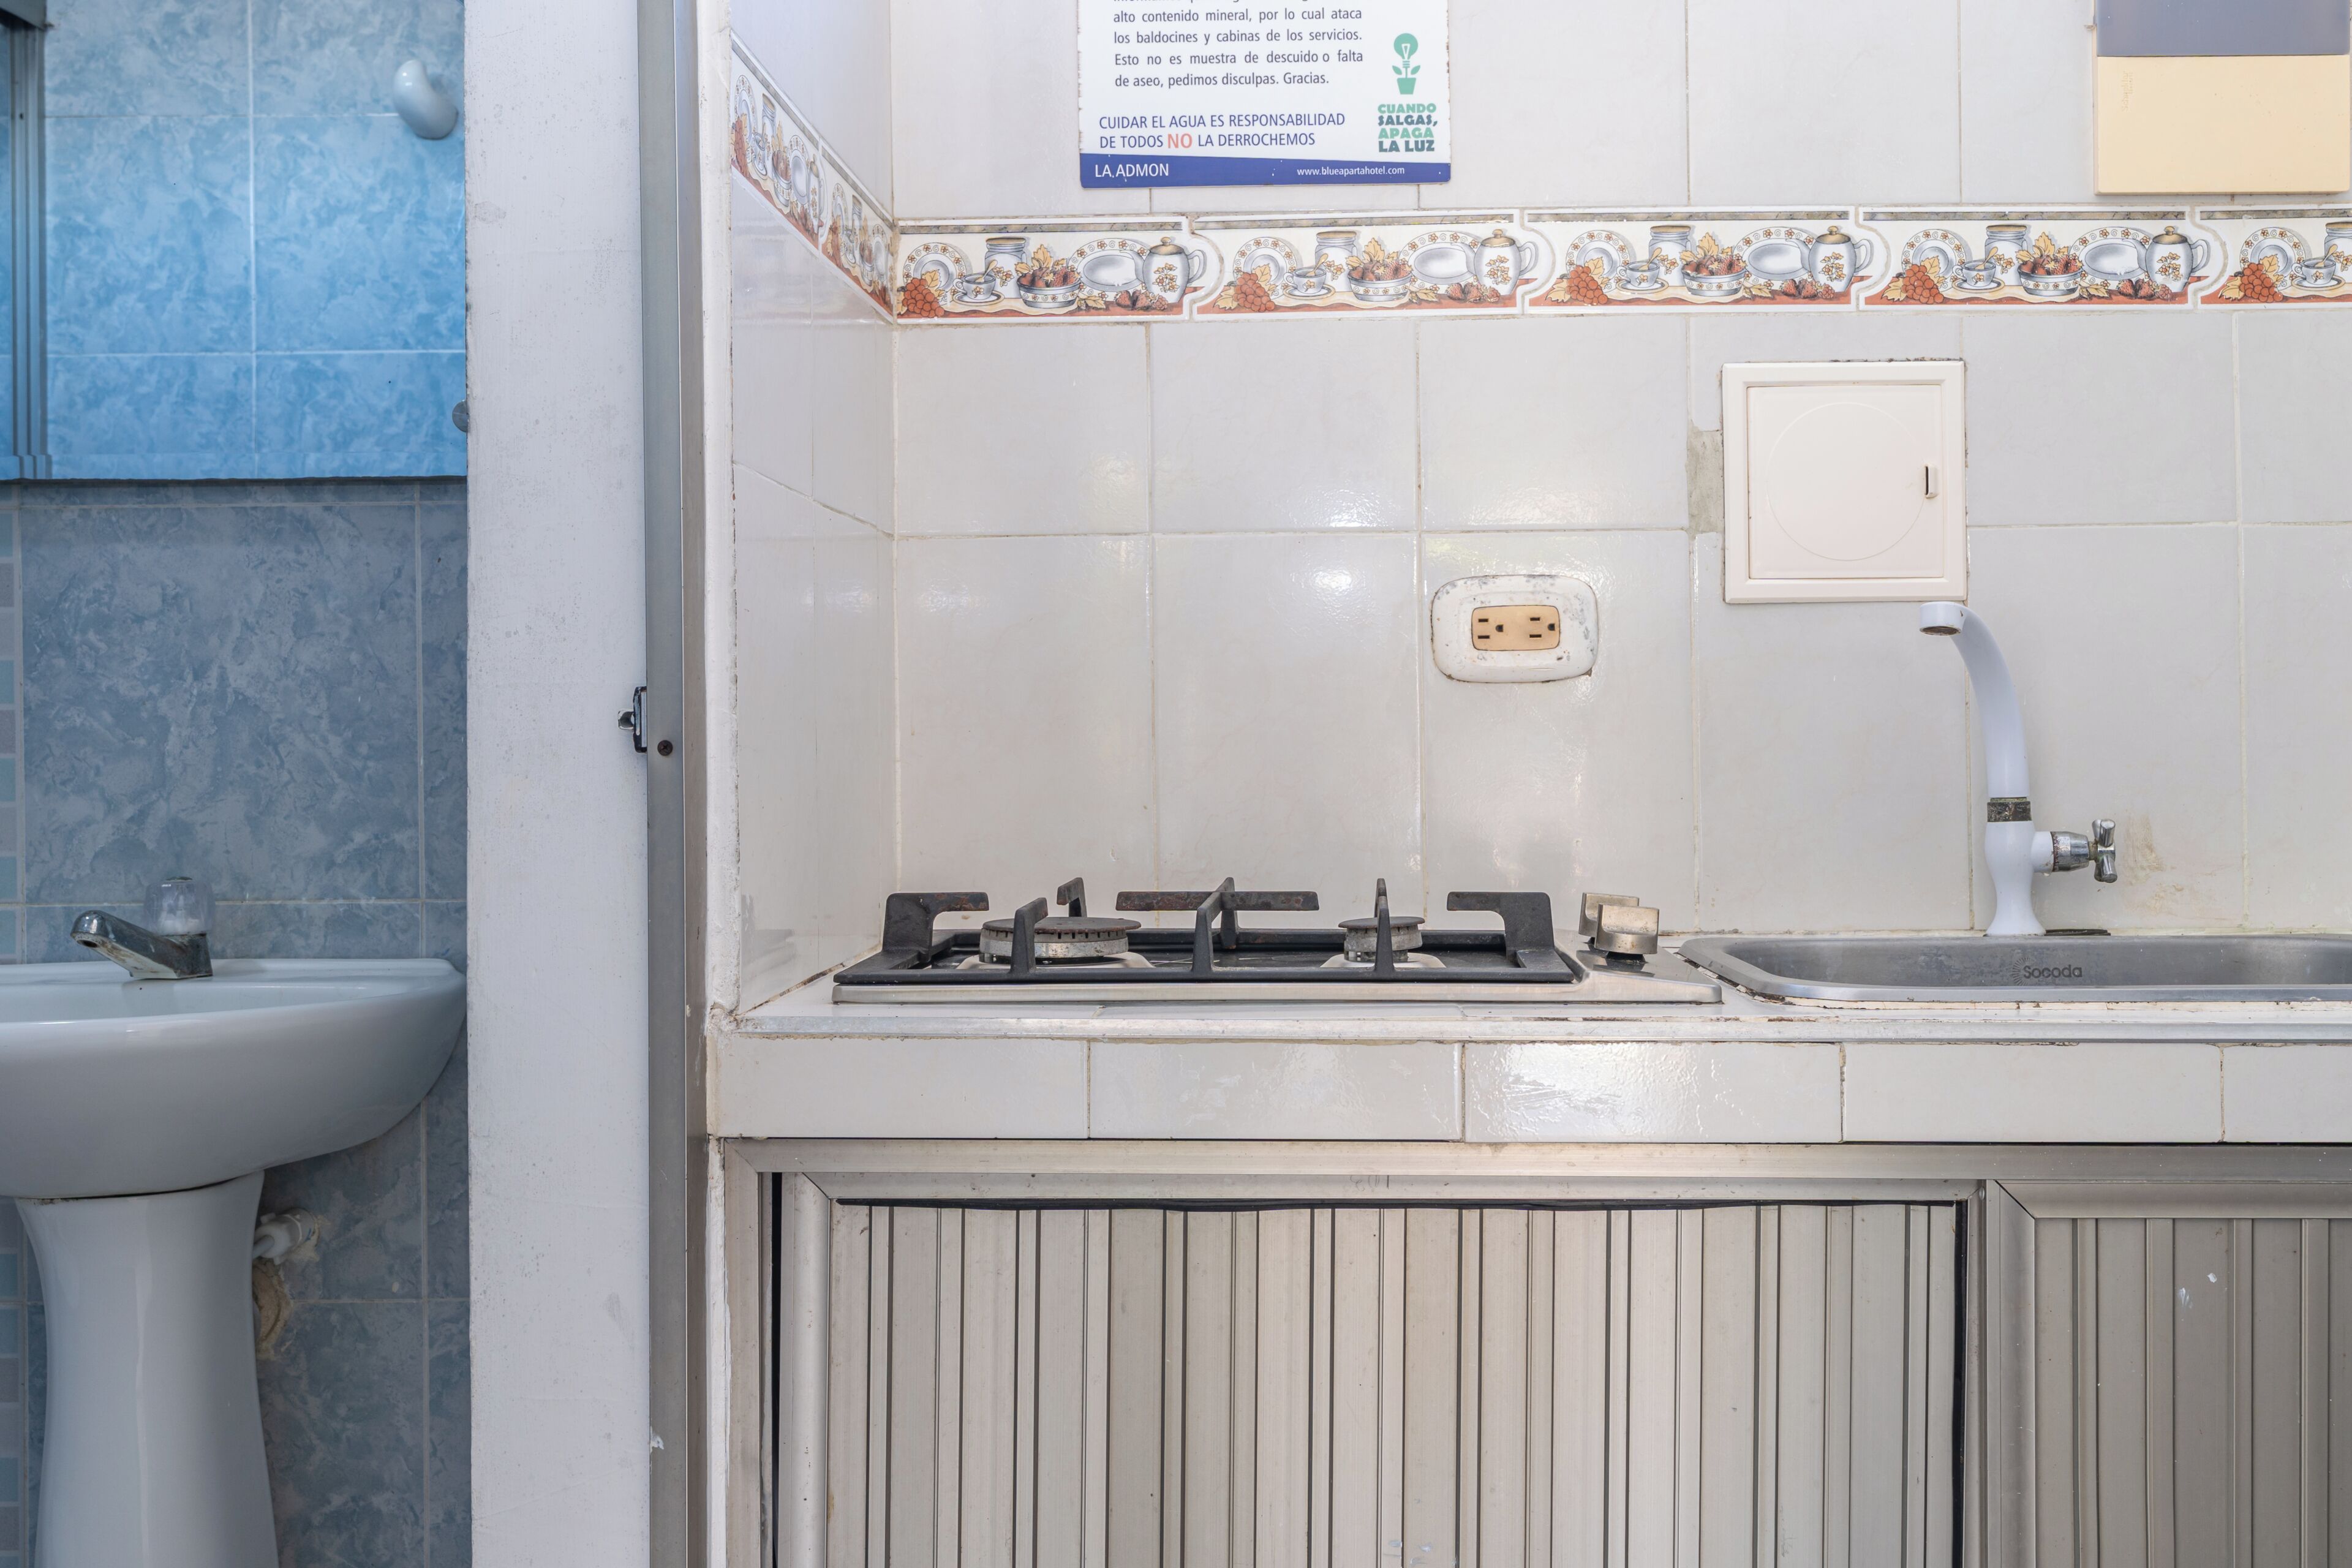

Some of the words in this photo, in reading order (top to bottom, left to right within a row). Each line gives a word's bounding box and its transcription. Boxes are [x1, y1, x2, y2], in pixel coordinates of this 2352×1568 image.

[1114, 10, 1136, 23] alto
[1142, 9, 1199, 22] contenido
[1205, 8, 1252, 22] mineral,
[1259, 11, 1278, 23] por
[1284, 7, 1295, 20] lo
[1301, 7, 1324, 20] cual
[1331, 9, 1362, 20] ataca
[1114, 31, 1130, 43] los
[1136, 31, 1198, 43] baldocines
[1204, 33, 1210, 45] y
[1216, 29, 1260, 42] cabinas
[1266, 29, 1281, 42] de
[1287, 29, 1303, 41] los
[1309, 28, 1362, 41] servicios.
[1115, 53, 1139, 66] Esto
[1147, 55, 1162, 65] no
[1169, 55, 1182, 65] es
[1190, 53, 1236, 64] muestra
[1244, 51, 1259, 64] de
[1266, 50, 1319, 63] descuido
[1322, 53, 1330, 62] o
[1337, 49, 1363, 62] falta
[1115, 74, 1129, 87] de
[1133, 77, 1164, 88] aseo,
[1168, 73, 1218, 89] pedimos
[1221, 72, 1279, 88] disculpas.
[1283, 72, 1329, 85] Gracias.
[1378, 103, 1437, 114] CUANDO
[1099, 116, 1148, 129] CUIDAR
[1152, 115, 1166, 128] EL
[1169, 115, 1207, 128] AGUA
[1210, 115, 1224, 127] ES
[1229, 113, 1345, 127] RESPONSABILIDAD
[1378, 115, 1438, 127] SALGAS,
[1100, 135, 1117, 149] DE
[1120, 134, 1164, 148] TODOS
[1167, 133, 1193, 149] NO
[1198, 134, 1215, 147] LA
[1218, 132, 1316, 146] DERROCHEMOS
[1378, 127, 1434, 139] APAGA
[1378, 140, 1400, 153] LA
[1404, 139, 1435, 153] LUZ
[1115, 163, 1169, 177] ADMON
[1297, 165, 1406, 177] www.blueapartahotel.com
[2023, 964, 2082, 979] Socoda
